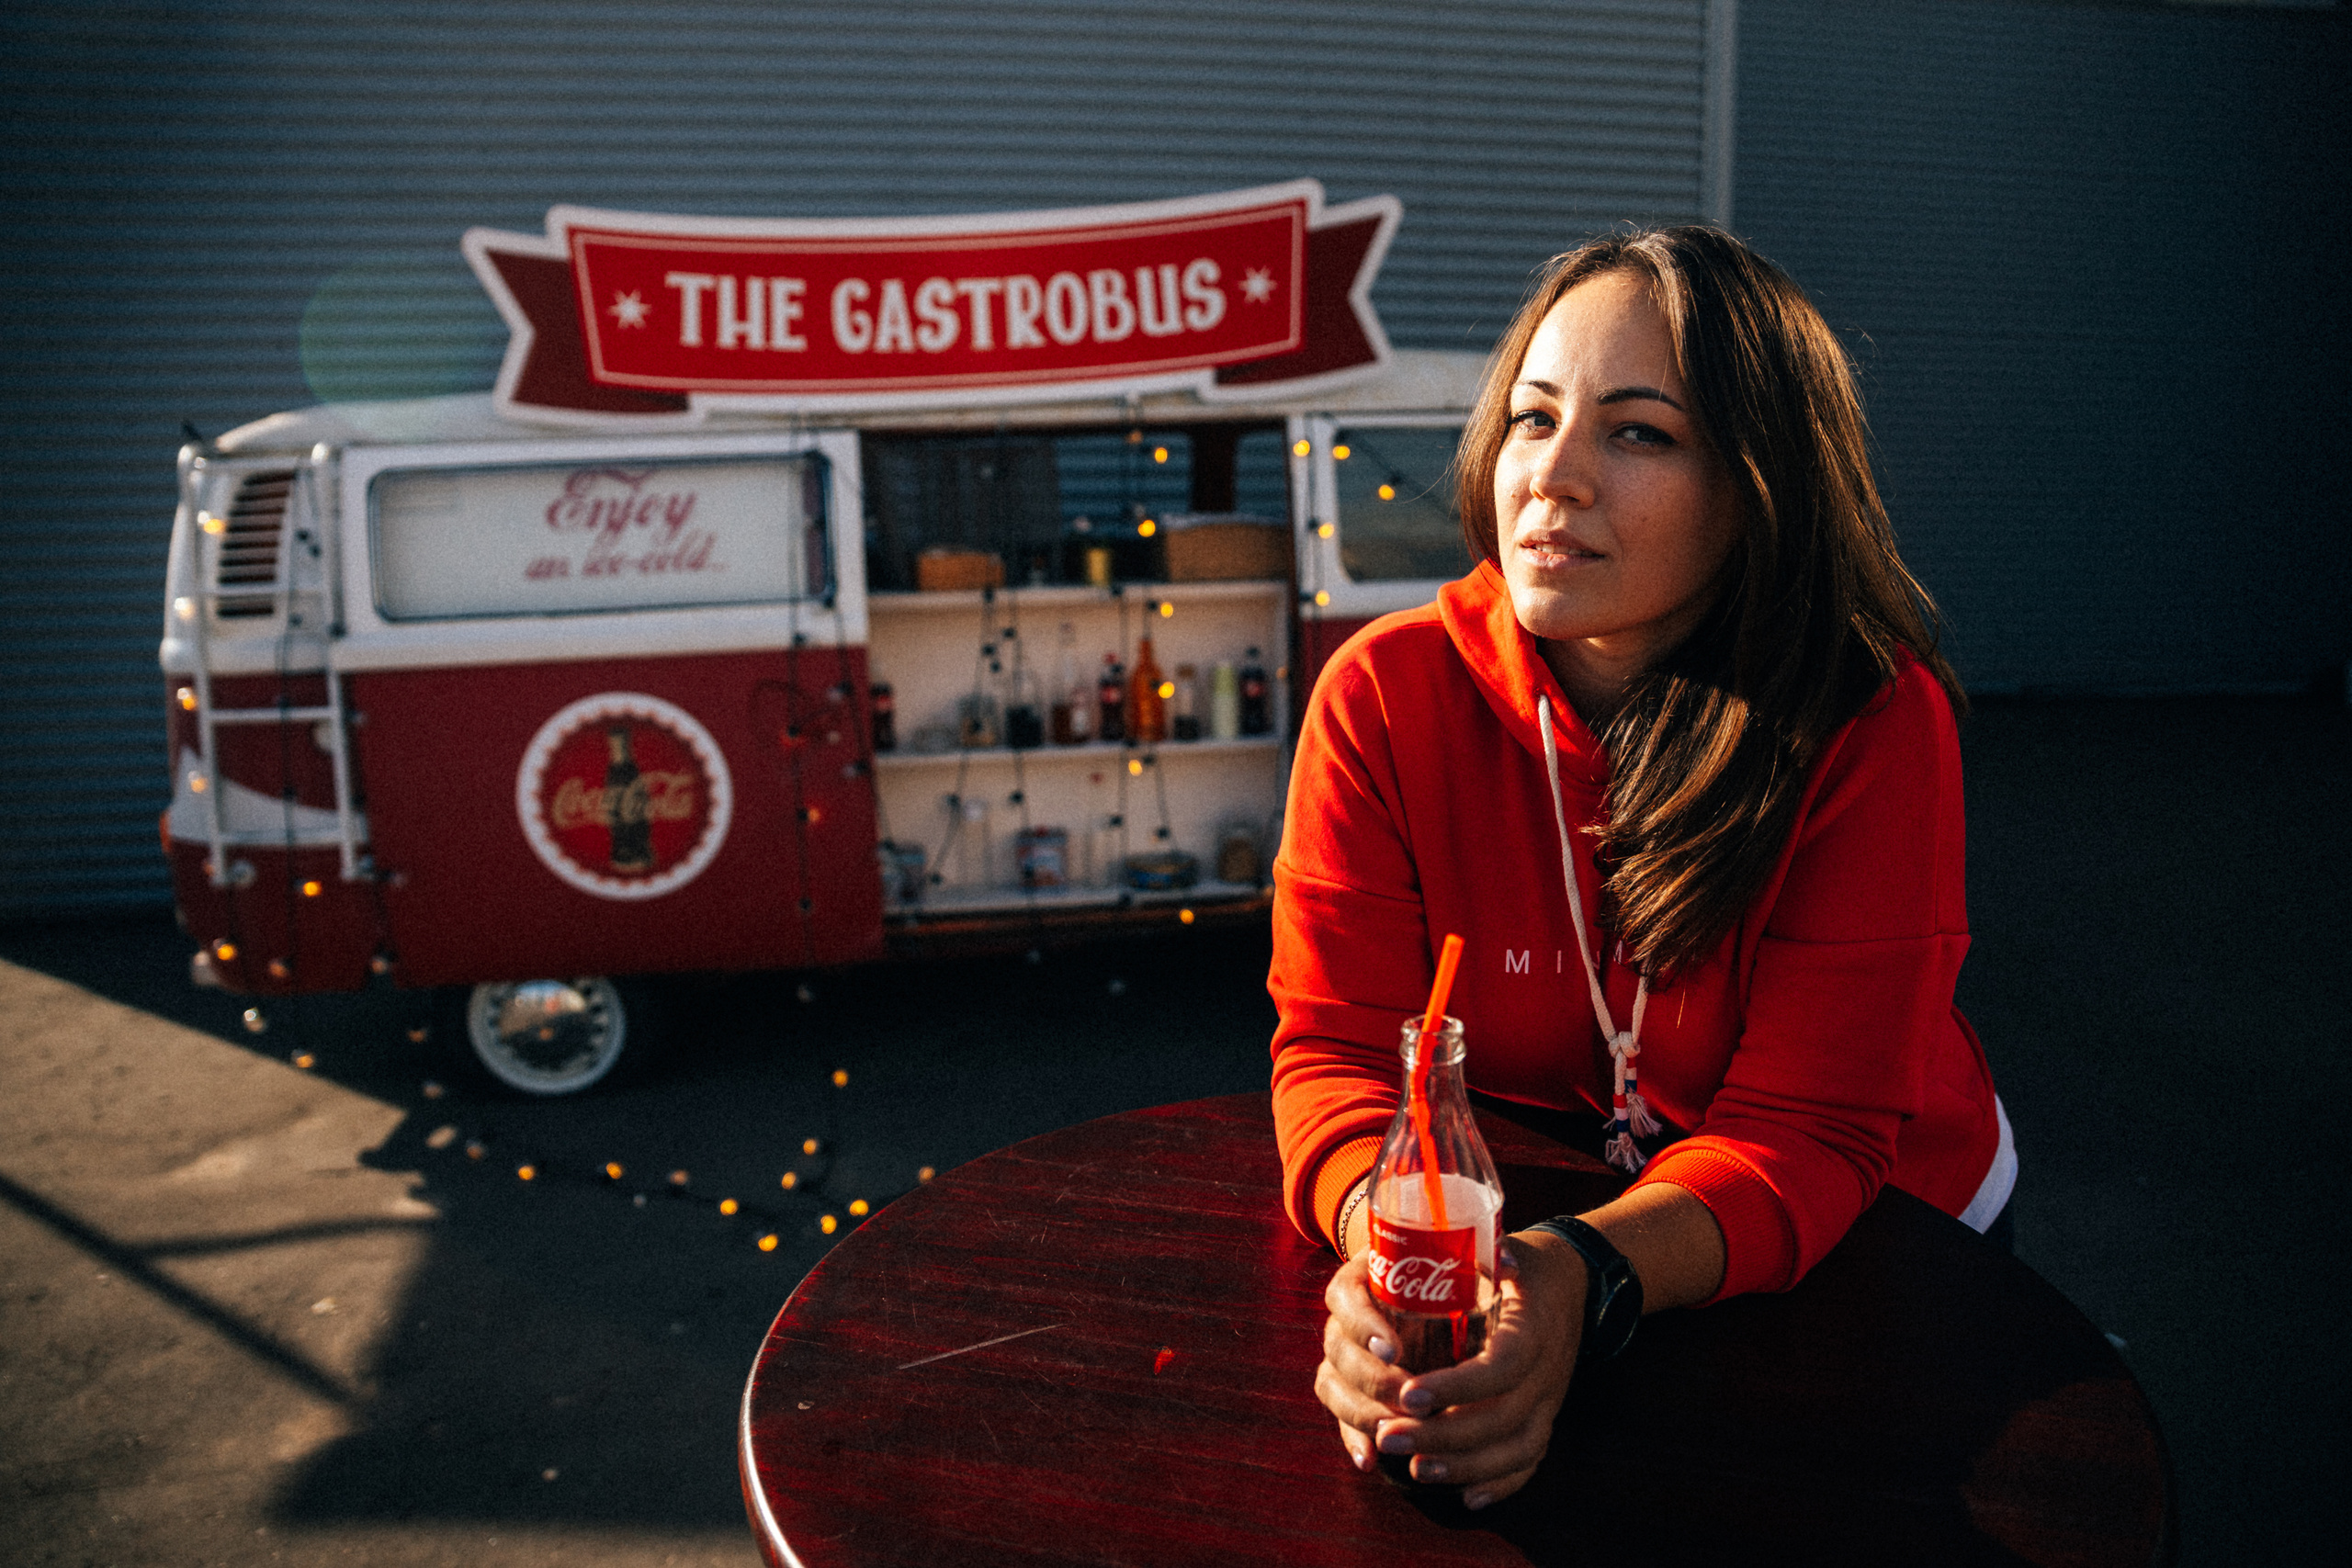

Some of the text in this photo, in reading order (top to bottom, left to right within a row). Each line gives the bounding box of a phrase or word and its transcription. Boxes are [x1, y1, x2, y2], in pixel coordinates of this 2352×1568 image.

[664, 257, 1227, 355] THE GASTROBUS
[544, 468, 698, 551] Enjoy
